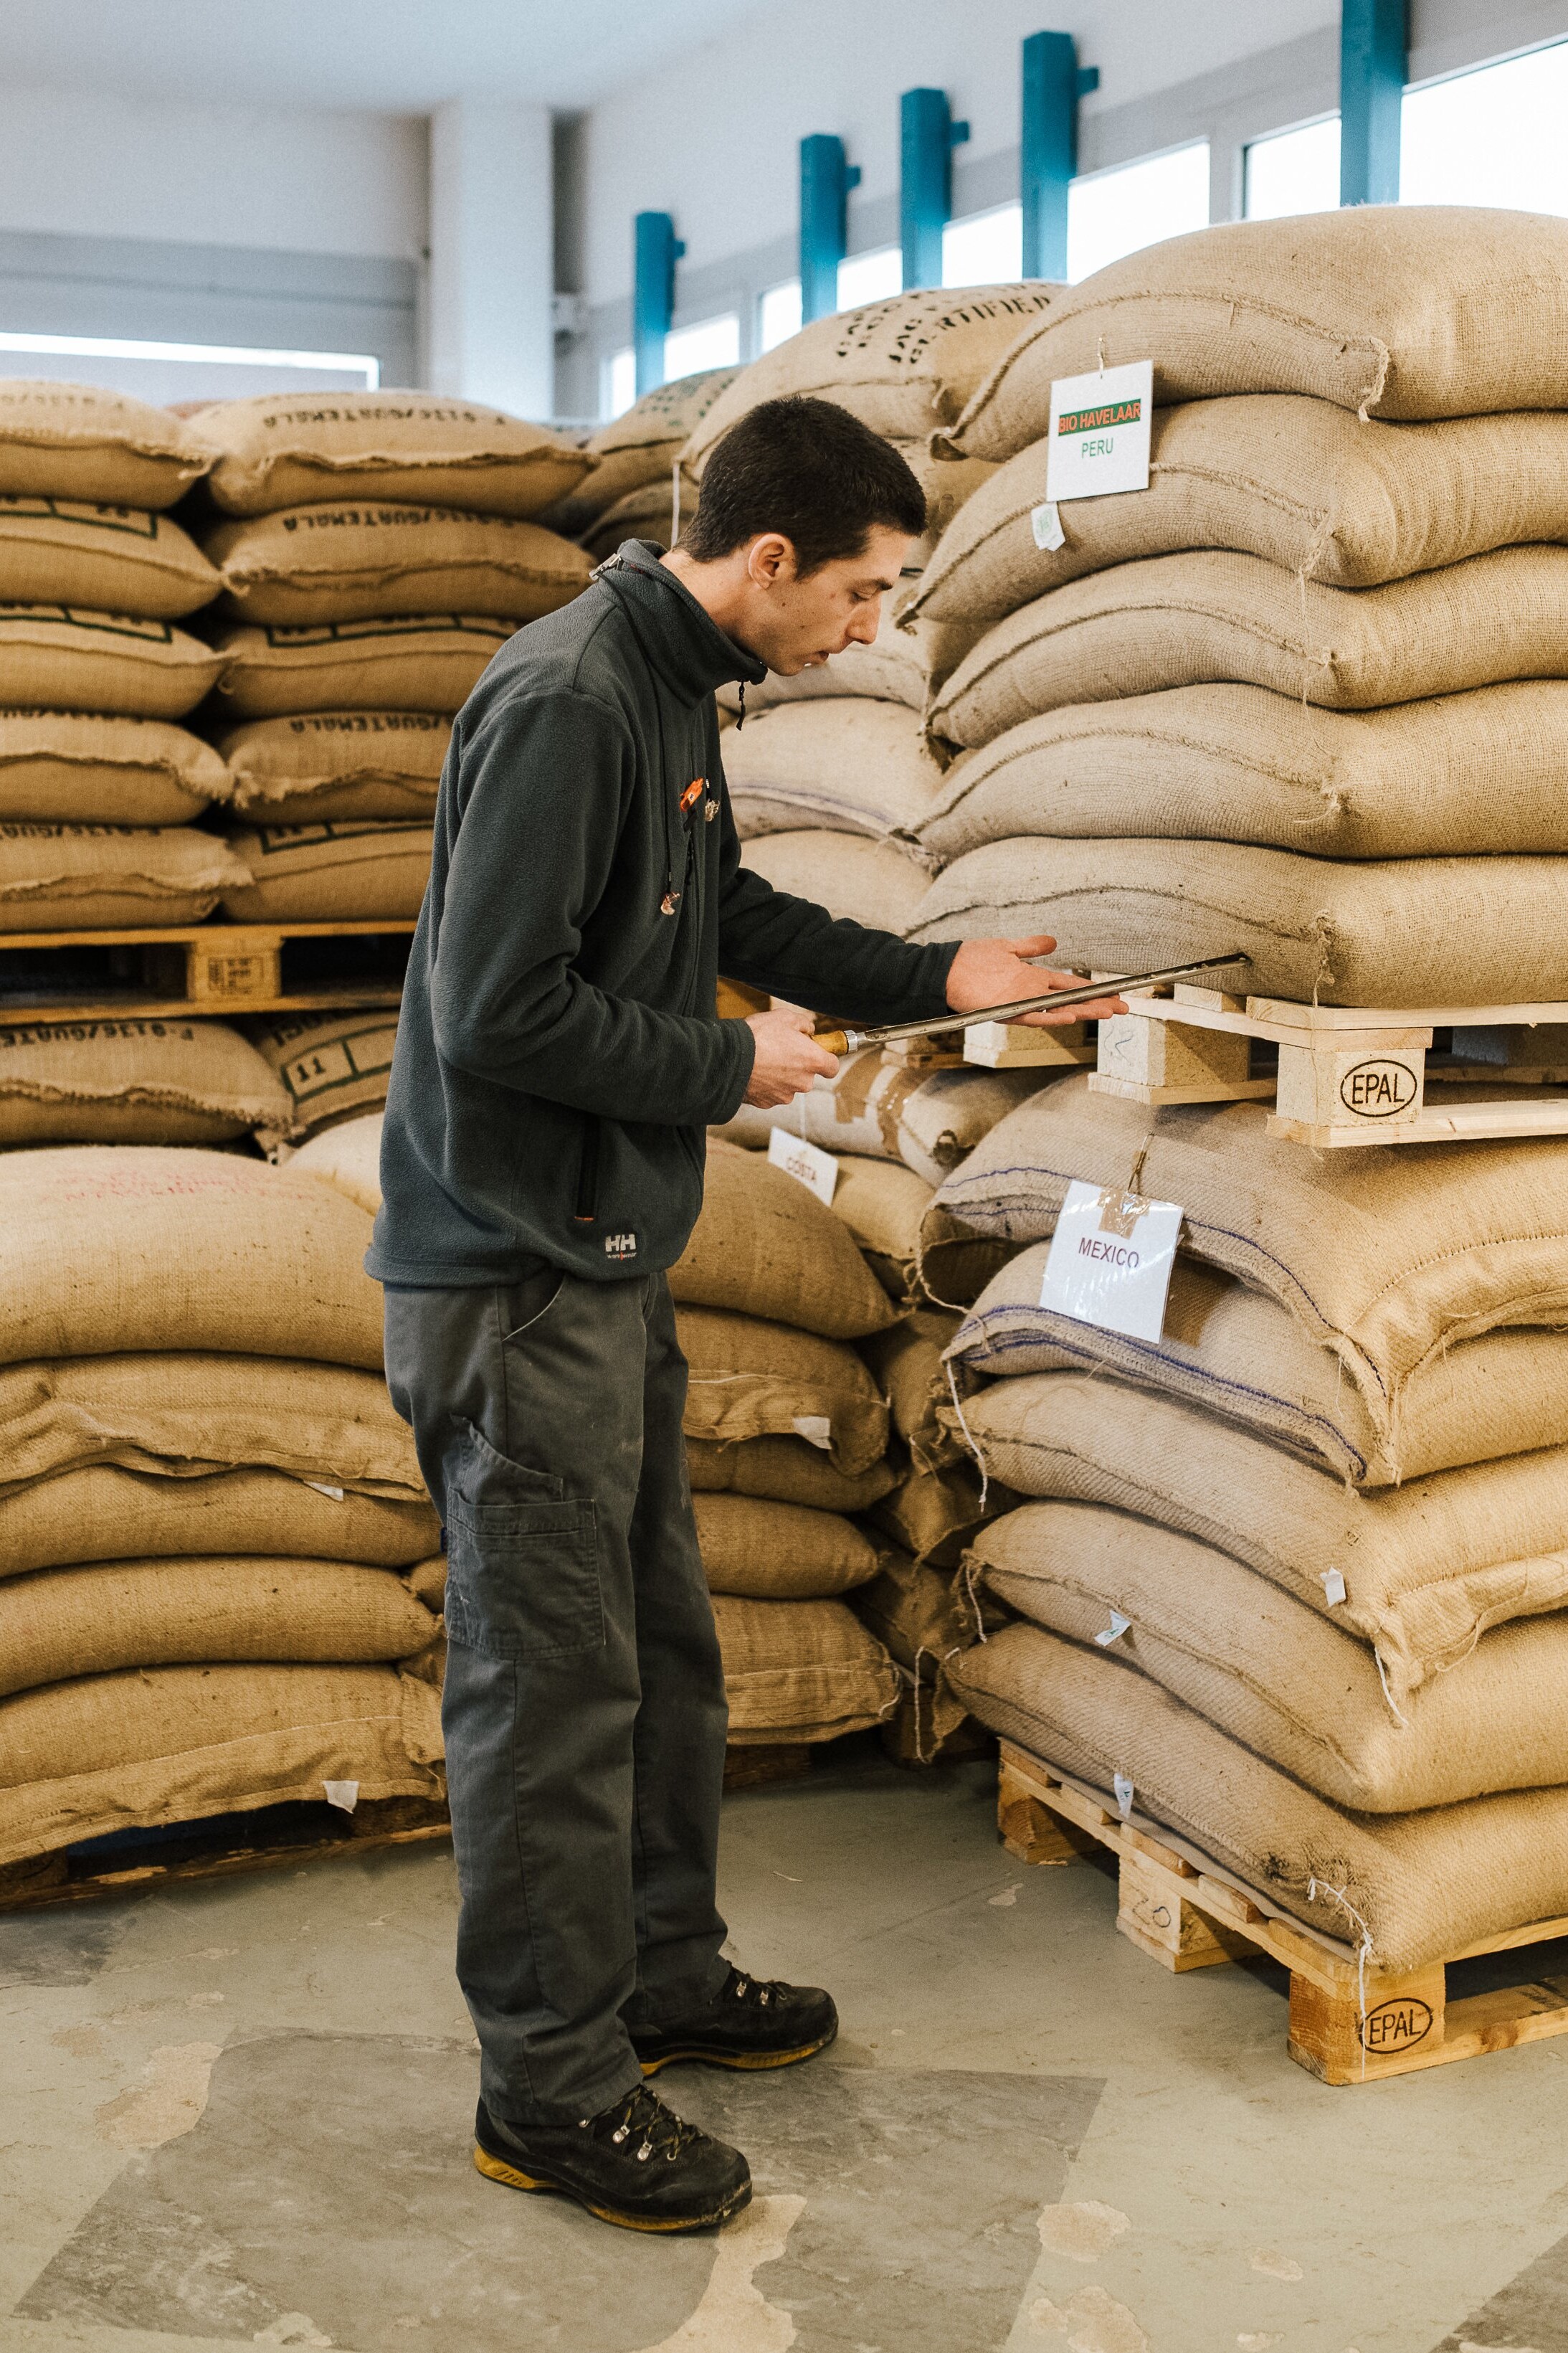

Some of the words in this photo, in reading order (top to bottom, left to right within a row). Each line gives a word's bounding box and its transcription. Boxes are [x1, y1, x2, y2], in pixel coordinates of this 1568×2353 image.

[1058, 415, 1078, 433] BIO
[1079, 402, 1141, 429] HAVELAAR
[1081, 437, 1114, 459] PERU
[1351, 1073, 1405, 1104] EPAL
[787, 1156, 817, 1181] COSTA
[605, 1234, 636, 1252] HH
[1078, 1237, 1139, 1268] MEXICO
[1369, 2009, 1421, 2045] EPAL
